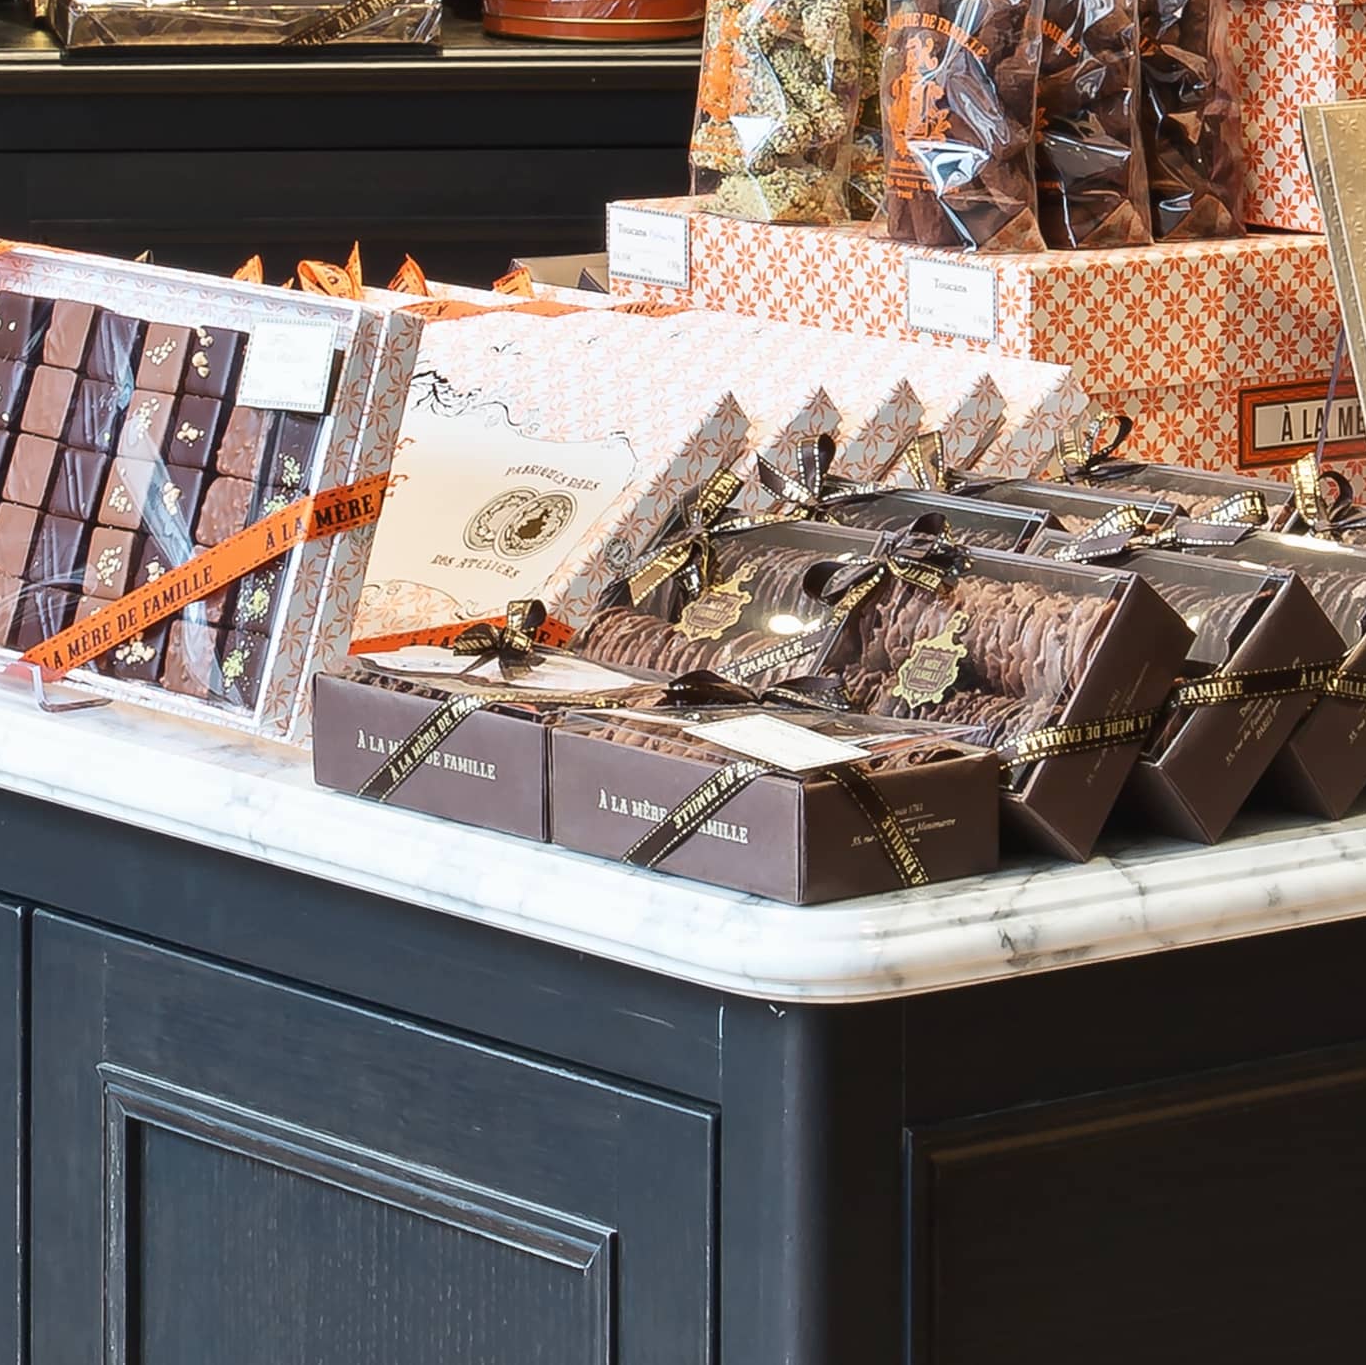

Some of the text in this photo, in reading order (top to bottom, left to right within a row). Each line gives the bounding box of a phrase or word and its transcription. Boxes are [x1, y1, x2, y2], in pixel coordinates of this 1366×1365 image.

[921, 12, 937, 27] DE
[1280, 401, 1328, 442] À LA
[265, 495, 375, 552] À LA MÈRE
[66, 620, 113, 659] MÈRE
[117, 606, 136, 631] DE
[143, 564, 214, 623] FAMILLE
[1178, 679, 1244, 702] FAMILLE
[1300, 668, 1325, 687] À LA
[357, 729, 386, 752] À LA
[389, 710, 453, 781] À LA MÈRE DE
[1017, 713, 1152, 754] FAMILLE DE MÈRE LA
[443, 751, 497, 781] FAMILLE
[599, 789, 608, 810] À
[611, 795, 628, 813] LA
[674, 782, 719, 827] FAMILLE
